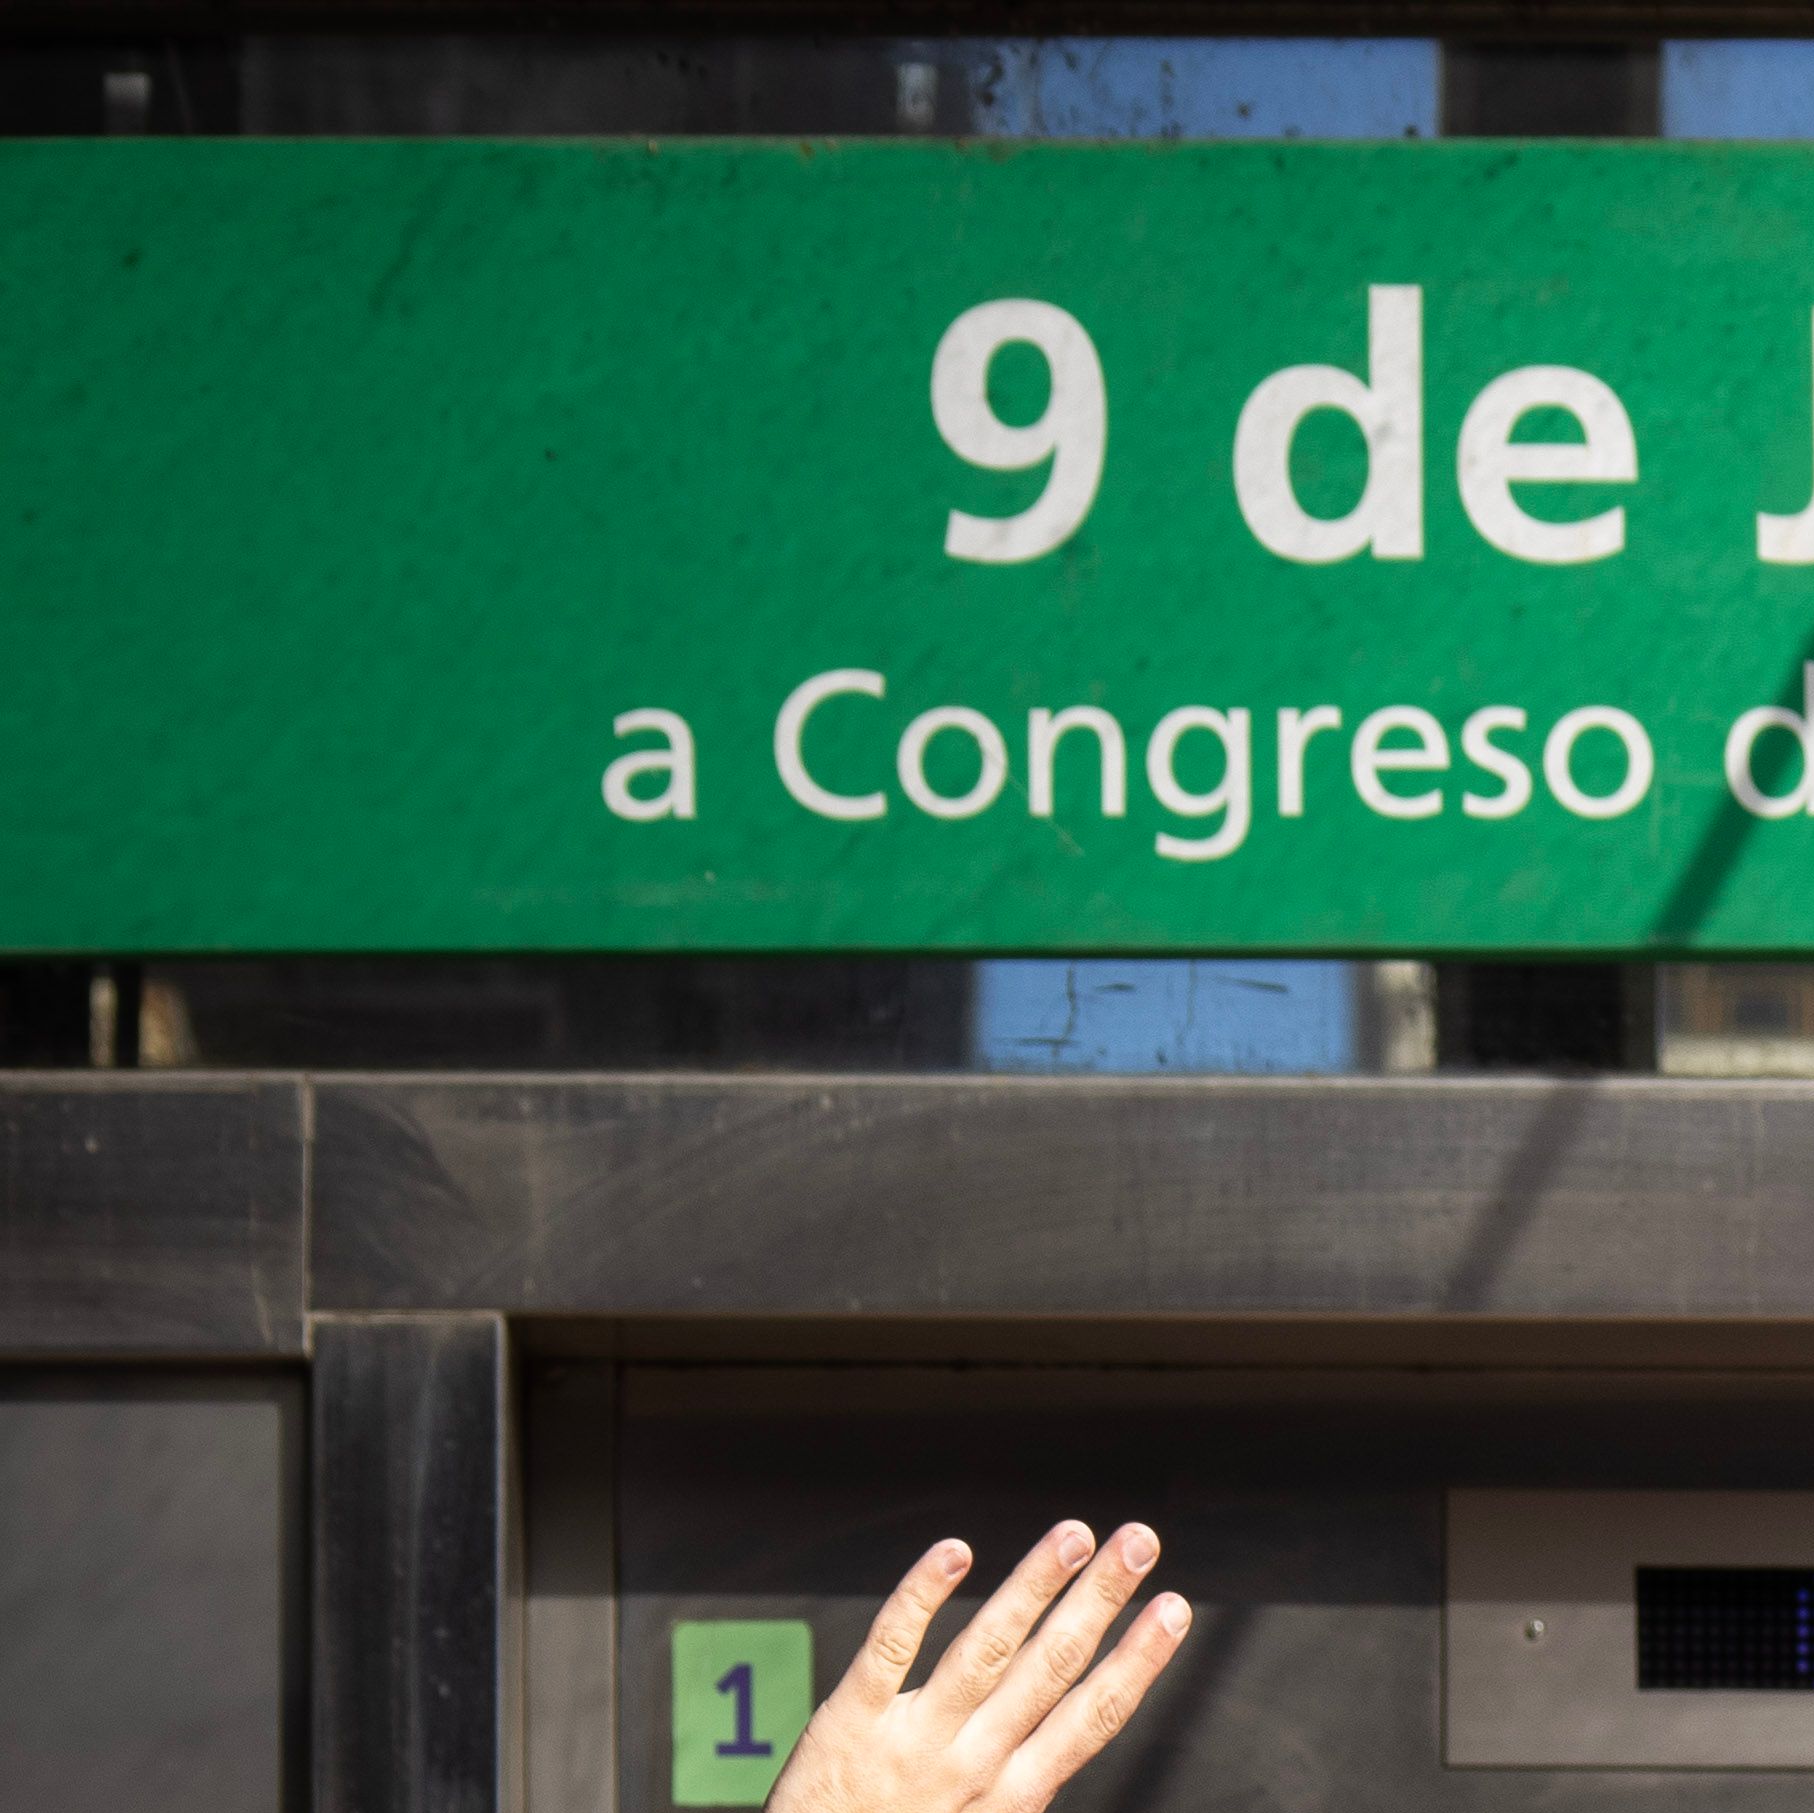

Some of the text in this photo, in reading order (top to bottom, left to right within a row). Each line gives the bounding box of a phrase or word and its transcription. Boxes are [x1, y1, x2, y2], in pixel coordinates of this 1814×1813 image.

[930, 298, 1108, 565] 9
[1232, 283, 1639, 567] de
[602, 708, 696, 821] a
[774, 668, 1655, 862] Congreso
[714, 1660, 775, 1758] 1
